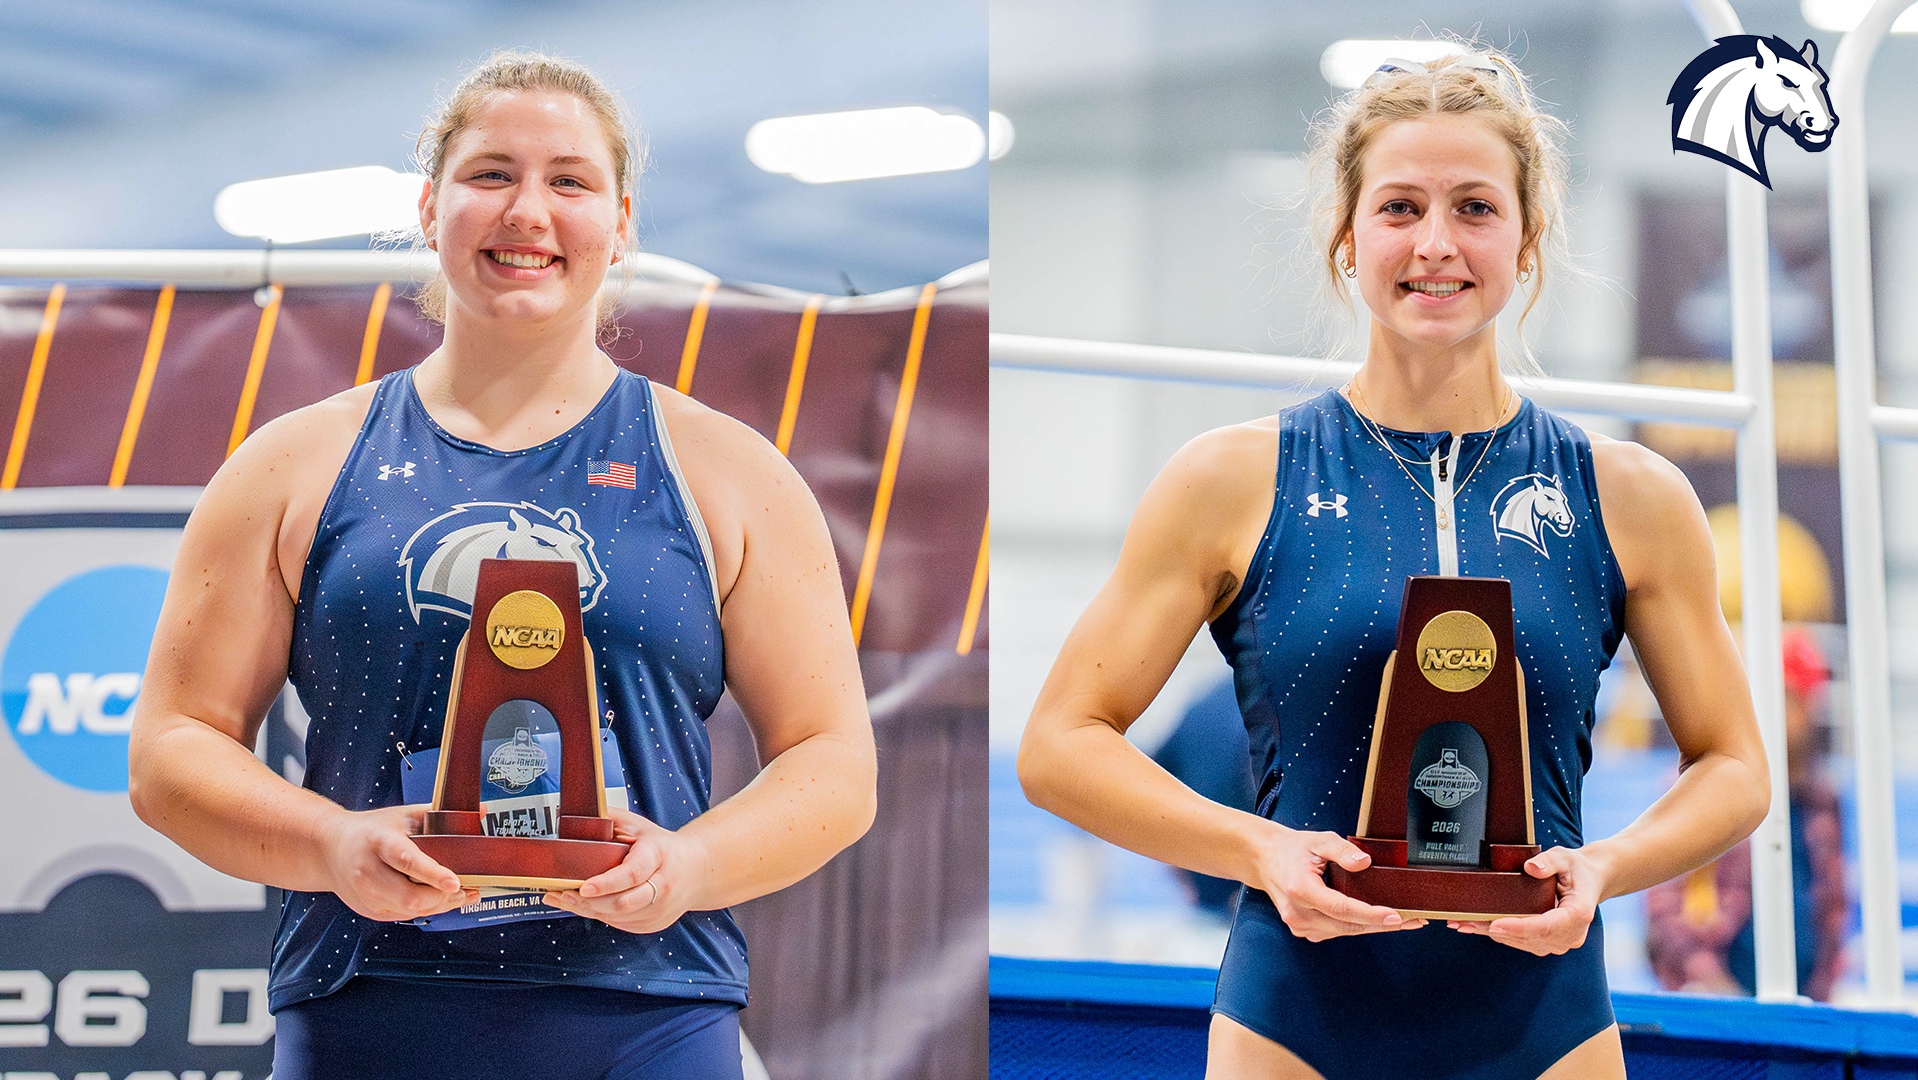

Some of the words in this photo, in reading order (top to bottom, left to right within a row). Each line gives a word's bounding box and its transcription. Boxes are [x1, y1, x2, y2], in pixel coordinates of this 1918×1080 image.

[492, 625, 561, 649] NCAA
[1423, 648, 1493, 671] NCAA
[17, 672, 142, 736] NC
[1415, 779, 1480, 790] CHAMPIONSHIPS
[1431, 821, 1461, 833] 2026
[460, 900, 497, 914] VIRGINIA
[498, 897, 528, 909] BEACH,
[529, 896, 541, 906] VA
